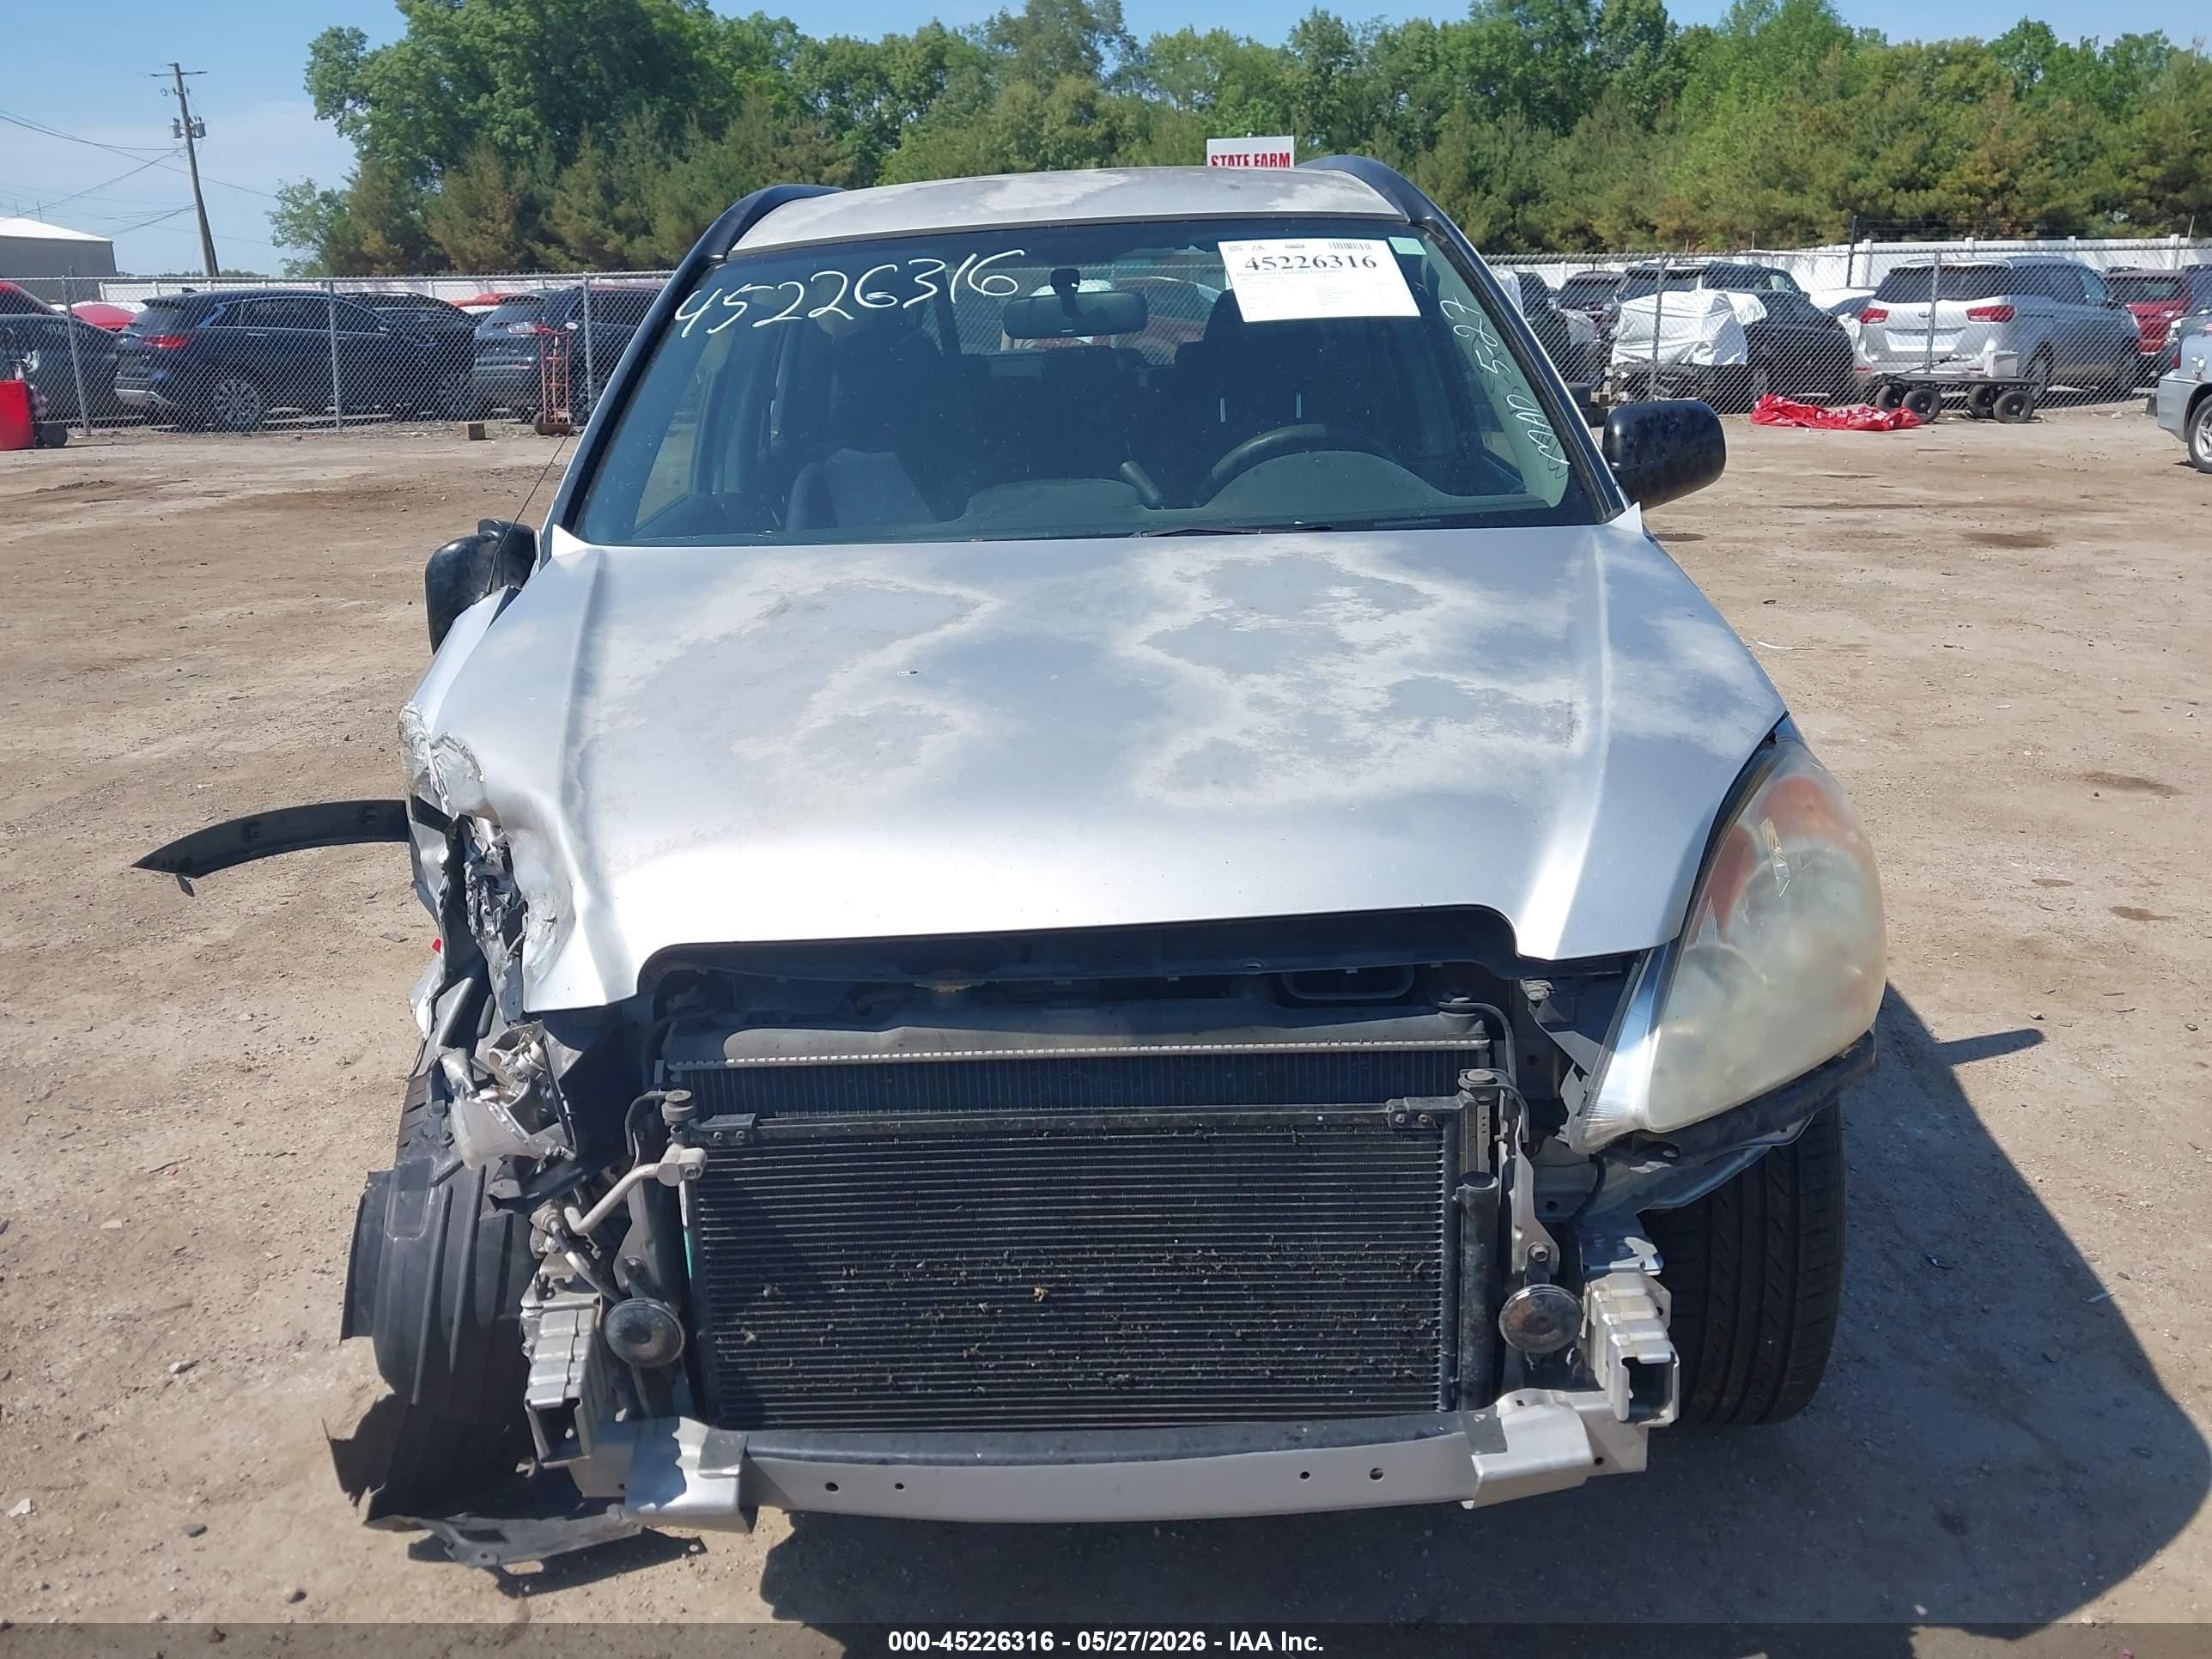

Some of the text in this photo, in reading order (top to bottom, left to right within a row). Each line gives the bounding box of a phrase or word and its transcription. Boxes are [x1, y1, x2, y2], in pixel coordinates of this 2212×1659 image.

[1210, 151, 1291, 168] STATE FARM
[1243, 254, 1377, 271] 45226316
[673, 248, 1026, 338] 45226316
